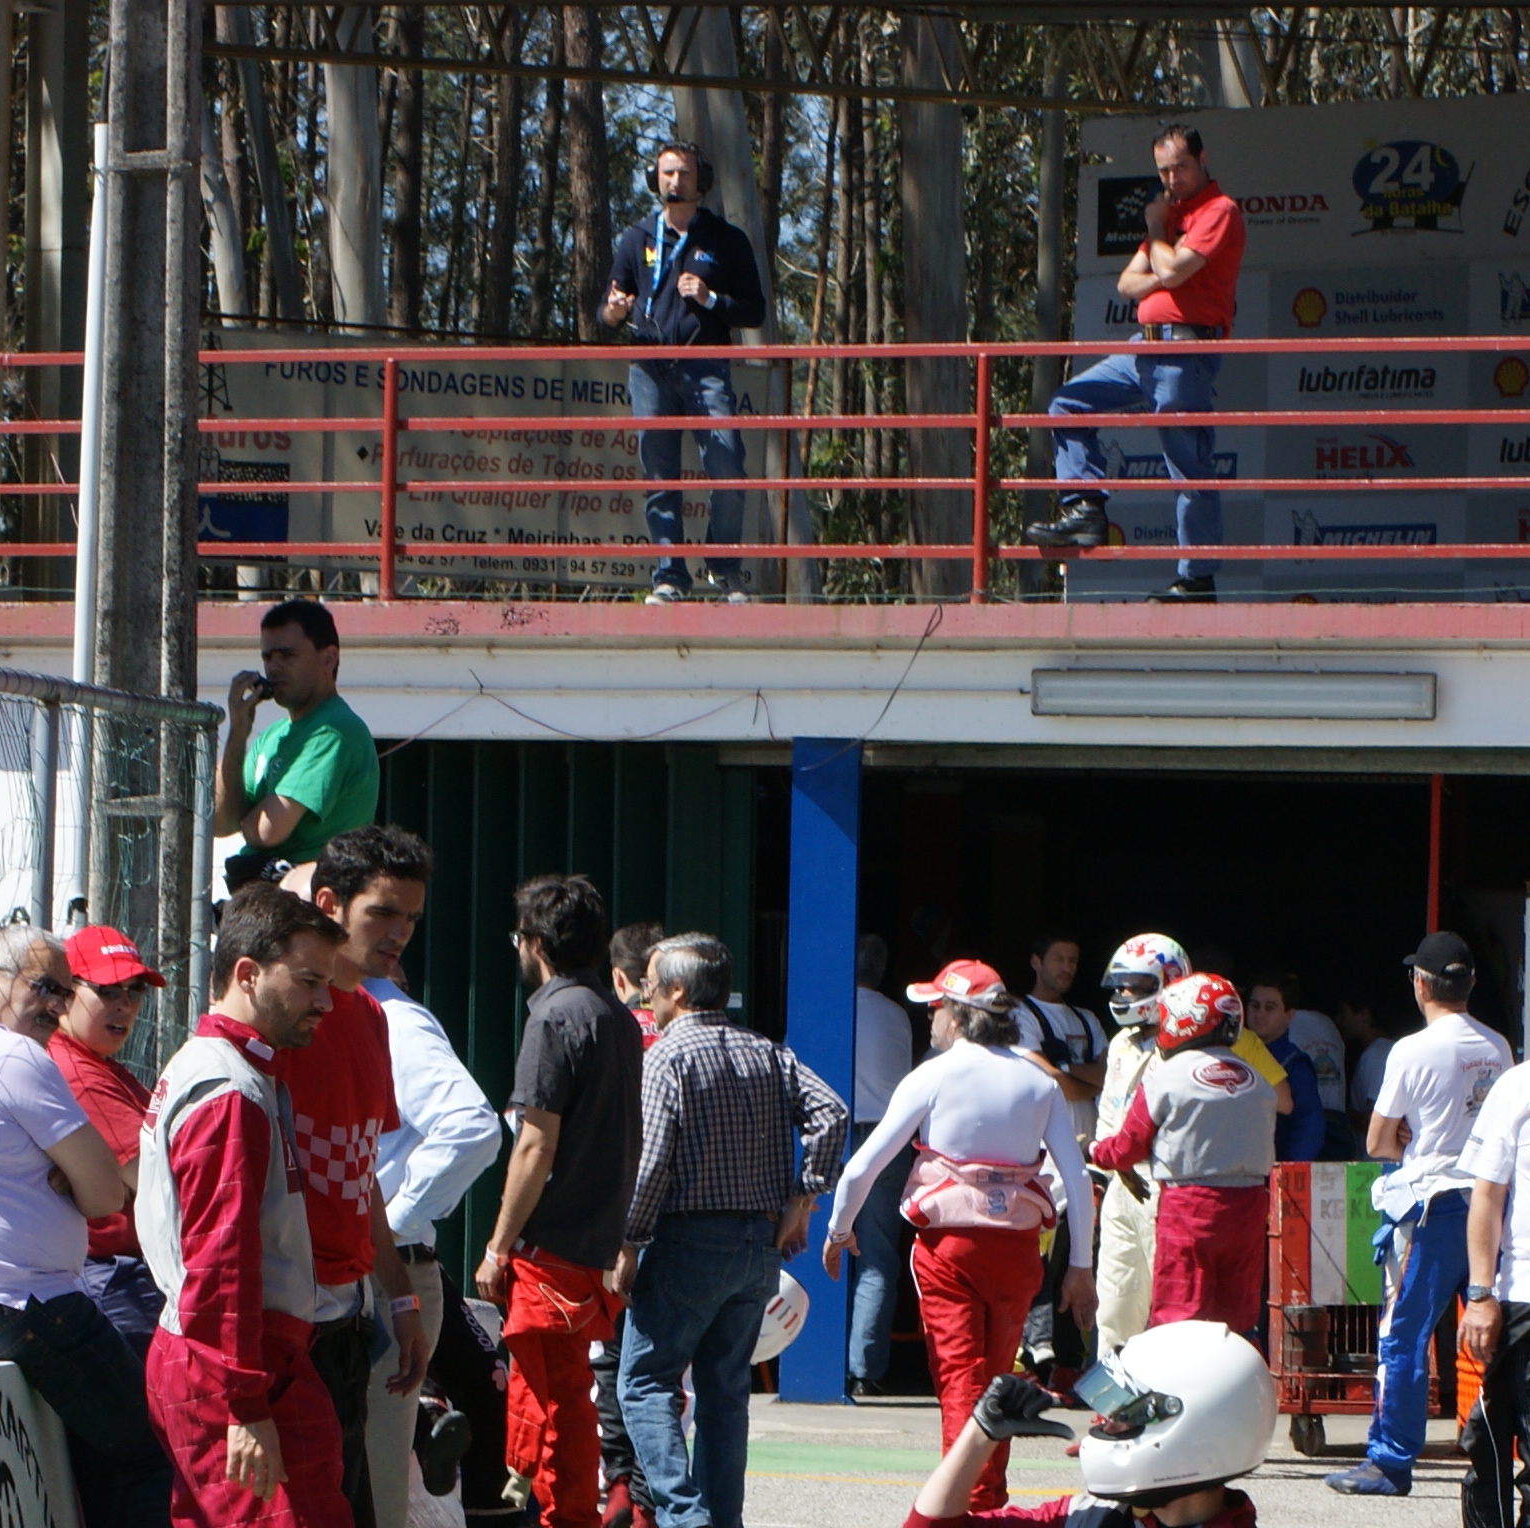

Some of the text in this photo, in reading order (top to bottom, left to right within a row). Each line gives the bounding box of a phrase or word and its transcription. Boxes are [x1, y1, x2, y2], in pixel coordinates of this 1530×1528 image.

[1368, 143, 1436, 193] 24
[1386, 200, 1453, 218] Batalha
[1335, 290, 1417, 305] Distribuidor
[1334, 307, 1444, 325] Shell Lubricants
[265, 361, 347, 385] FUROS
[355, 365, 369, 388] E
[533, 378, 564, 401] DE
[572, 380, 631, 406] MEIR
[1298, 364, 1437, 393] lubrifatima
[370, 449, 501, 475] Prfurações
[507, 456, 534, 476] de
[542, 455, 605, 480] Todos
[611, 466, 637, 482] os
[1316, 444, 1415, 471] HELIX
[609, 494, 634, 514] de
[364, 518, 405, 541] Vae
[411, 520, 435, 541] da
[441, 522, 488, 545] Cruz
[472, 556, 518, 572] Telem.
[523, 557, 557, 572] 0931
[570, 560, 586, 574] 94
[591, 561, 606, 575] 57
[611, 562, 636, 576] 529
